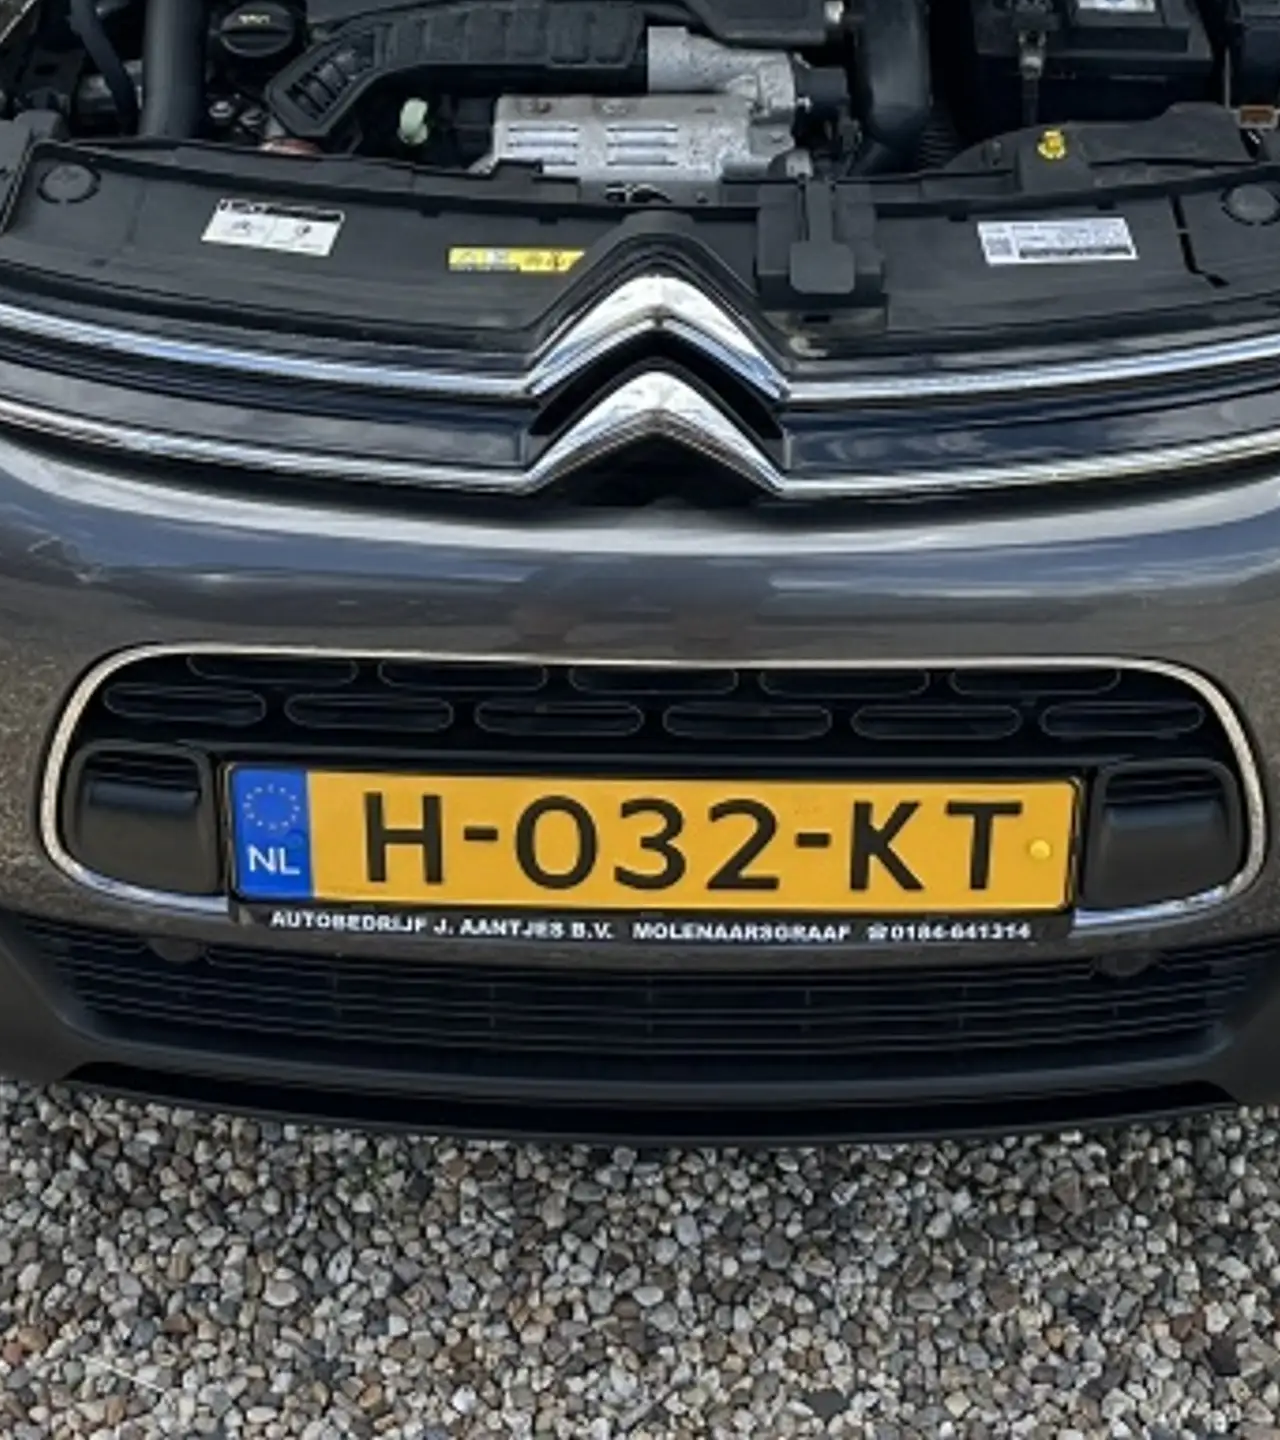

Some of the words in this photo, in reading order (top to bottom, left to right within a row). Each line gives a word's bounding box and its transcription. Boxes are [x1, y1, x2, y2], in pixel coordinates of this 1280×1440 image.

[363, 789, 1022, 891] H-032-KT
[246, 844, 300, 876] NL
[270, 910, 427, 934] AUTOBEDRIJF
[433, 915, 454, 936] J.
[459, 917, 565, 939] AANTJES
[571, 921, 615, 940] B.V.
[631, 921, 851, 944] MOLENAARSGRAAF
